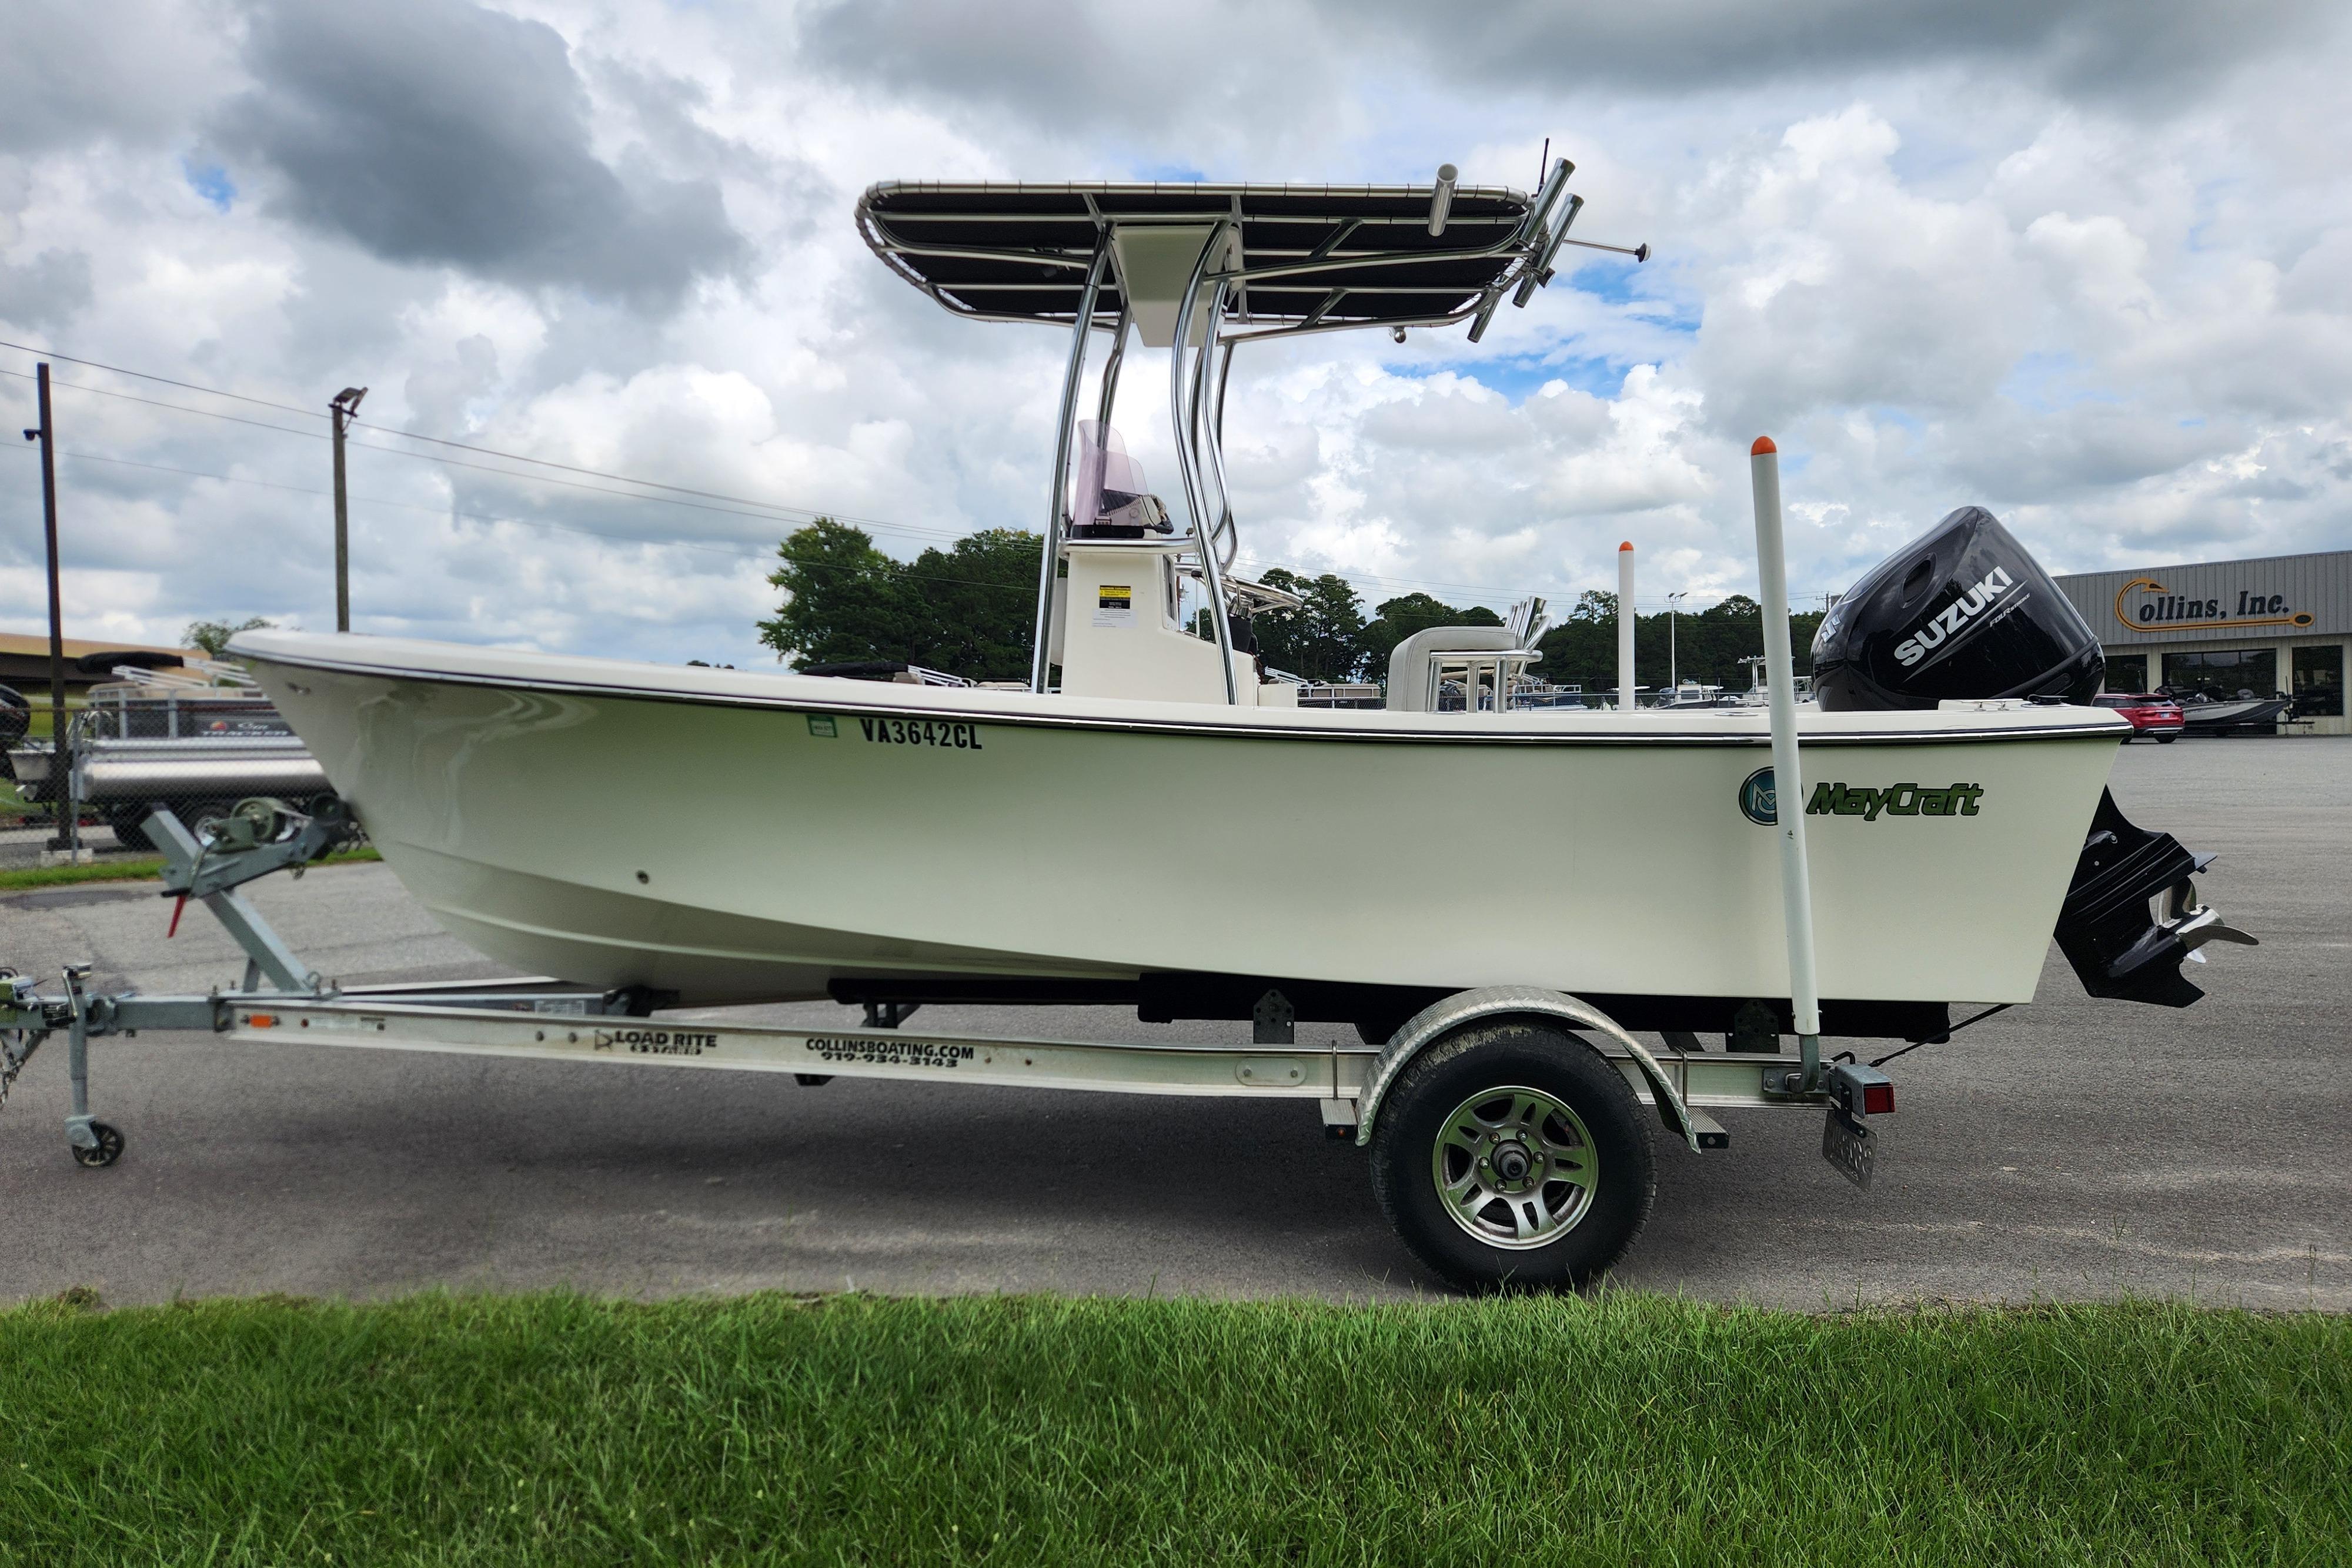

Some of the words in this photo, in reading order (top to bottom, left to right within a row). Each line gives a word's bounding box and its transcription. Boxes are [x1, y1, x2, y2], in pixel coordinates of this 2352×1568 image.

[1894, 566, 2013, 666] SUZUKI
[2237, 591, 2289, 616] Inc.
[859, 717, 983, 750] VA3642CL
[1805, 782, 1984, 821] MayCraft
[615, 1030, 669, 1045] LOAD
[674, 1034, 717, 1047] RITE
[806, 1038, 974, 1059] COLLINSBOATING.COM
